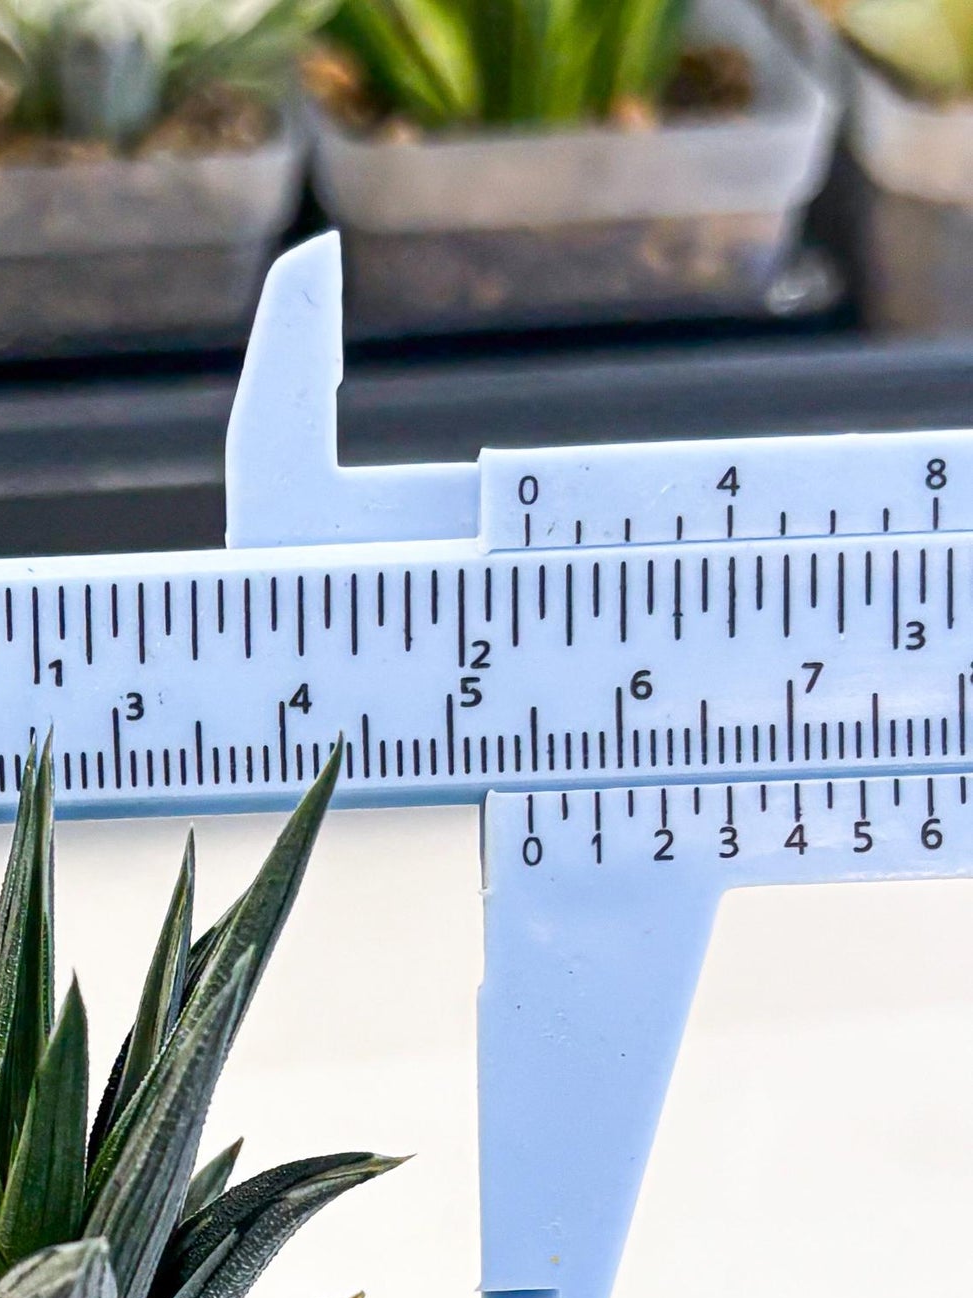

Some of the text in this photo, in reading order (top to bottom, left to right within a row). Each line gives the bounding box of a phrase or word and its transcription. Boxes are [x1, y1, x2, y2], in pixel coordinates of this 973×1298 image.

[518, 458, 948, 506] 0 4 8
[48, 658, 63, 688] 1
[469, 639, 491, 670] 2
[905, 620, 926, 651] 3
[125, 691, 145, 722] 3
[288, 682, 313, 715] 4
[460, 676, 483, 708] 5
[629, 669, 653, 701] 6
[801, 661, 824, 694] 7
[522, 818, 943, 867] 0 1 2 3 4 5 6
